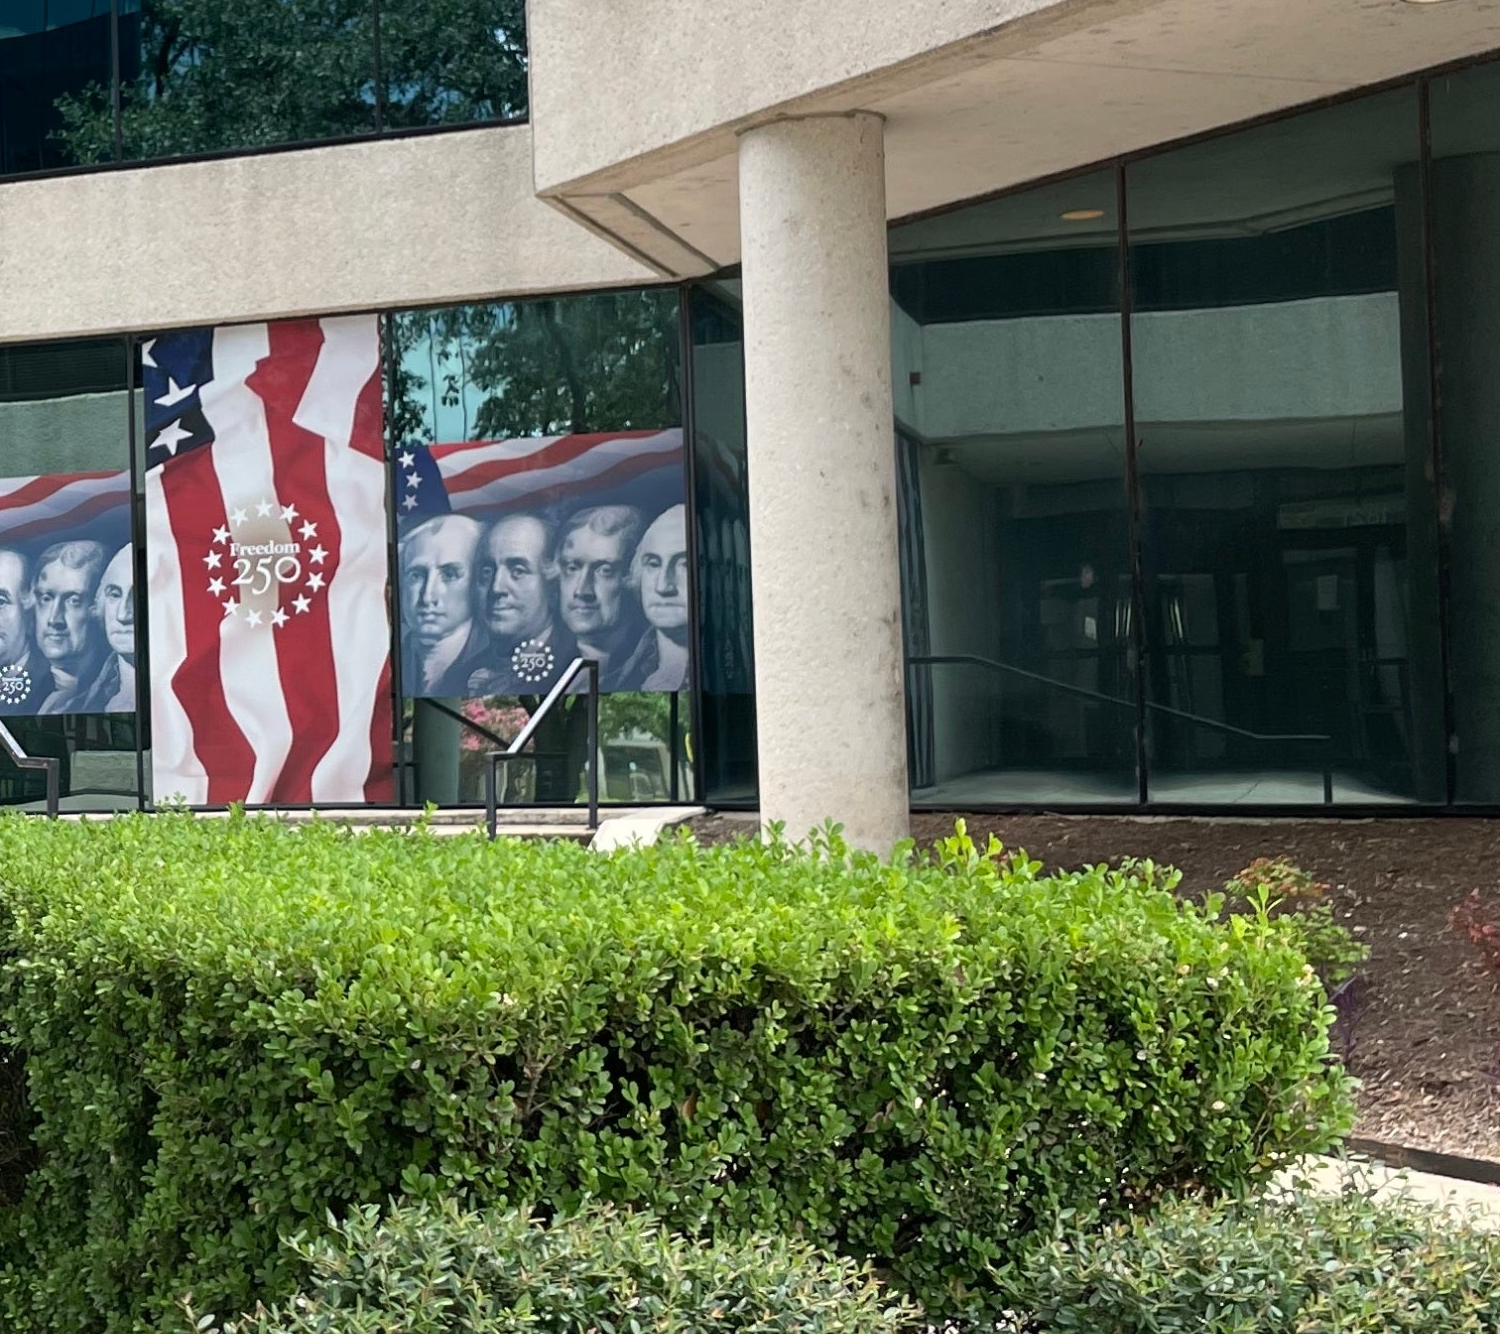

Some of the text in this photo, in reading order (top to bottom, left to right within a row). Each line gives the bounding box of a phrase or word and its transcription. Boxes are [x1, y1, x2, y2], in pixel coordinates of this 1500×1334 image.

[230, 540, 301, 557] Freedom
[231, 556, 301, 595] 250
[520, 657, 546, 672] 250
[2, 681, 24, 694] 250
